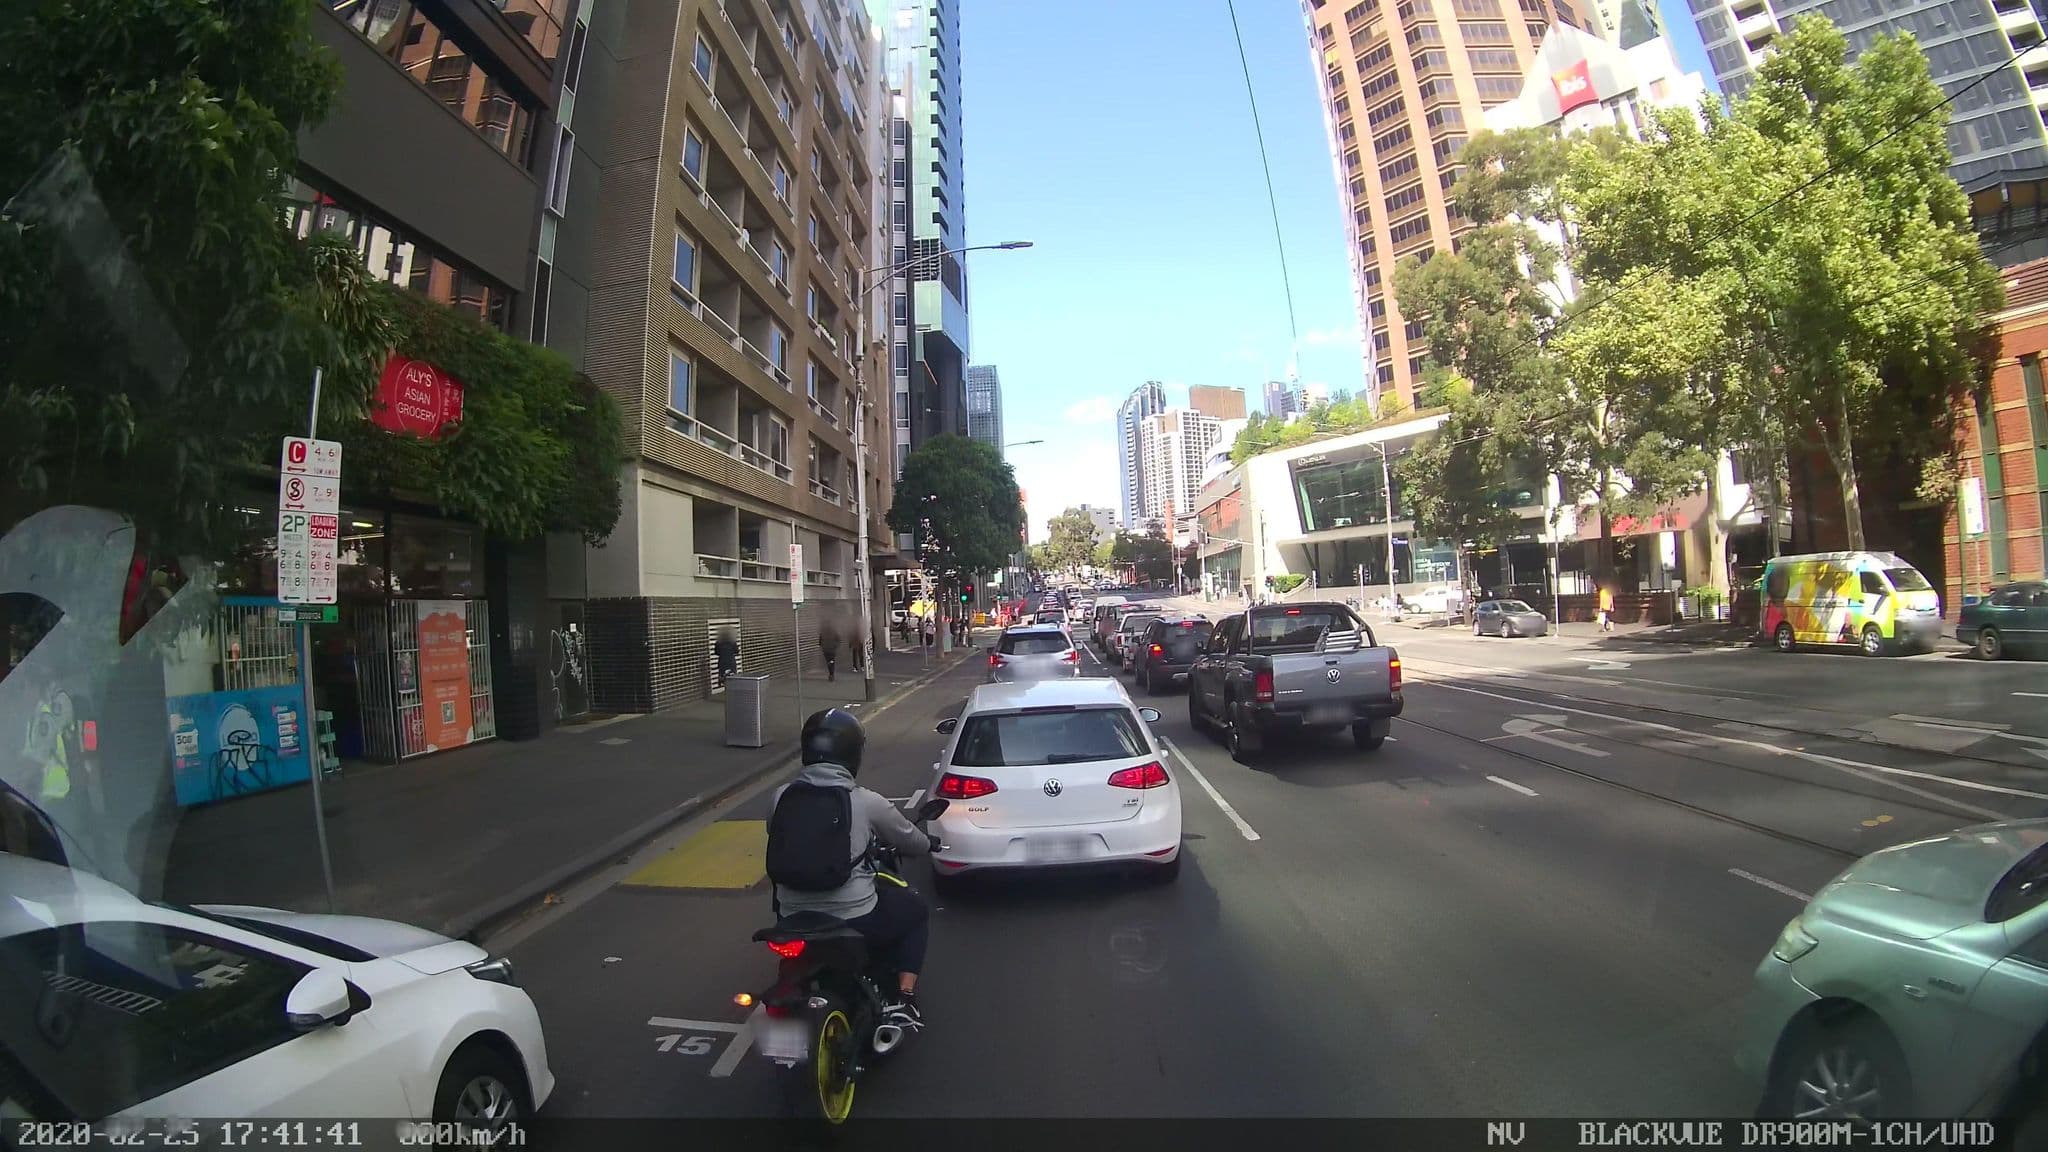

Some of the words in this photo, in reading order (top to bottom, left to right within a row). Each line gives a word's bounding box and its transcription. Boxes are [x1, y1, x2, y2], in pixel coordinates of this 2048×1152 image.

[1560, 74, 1587, 97] ibis
[406, 367, 432, 387] ALY'S
[404, 386, 431, 405] ASIAN
[396, 401, 436, 423] GROCERY
[328, 448, 335, 457] 6
[282, 515, 305, 533] 2P
[311, 515, 336, 527] LOADING
[310, 527, 337, 538] ZONE
[655, 1034, 717, 1055] 15
